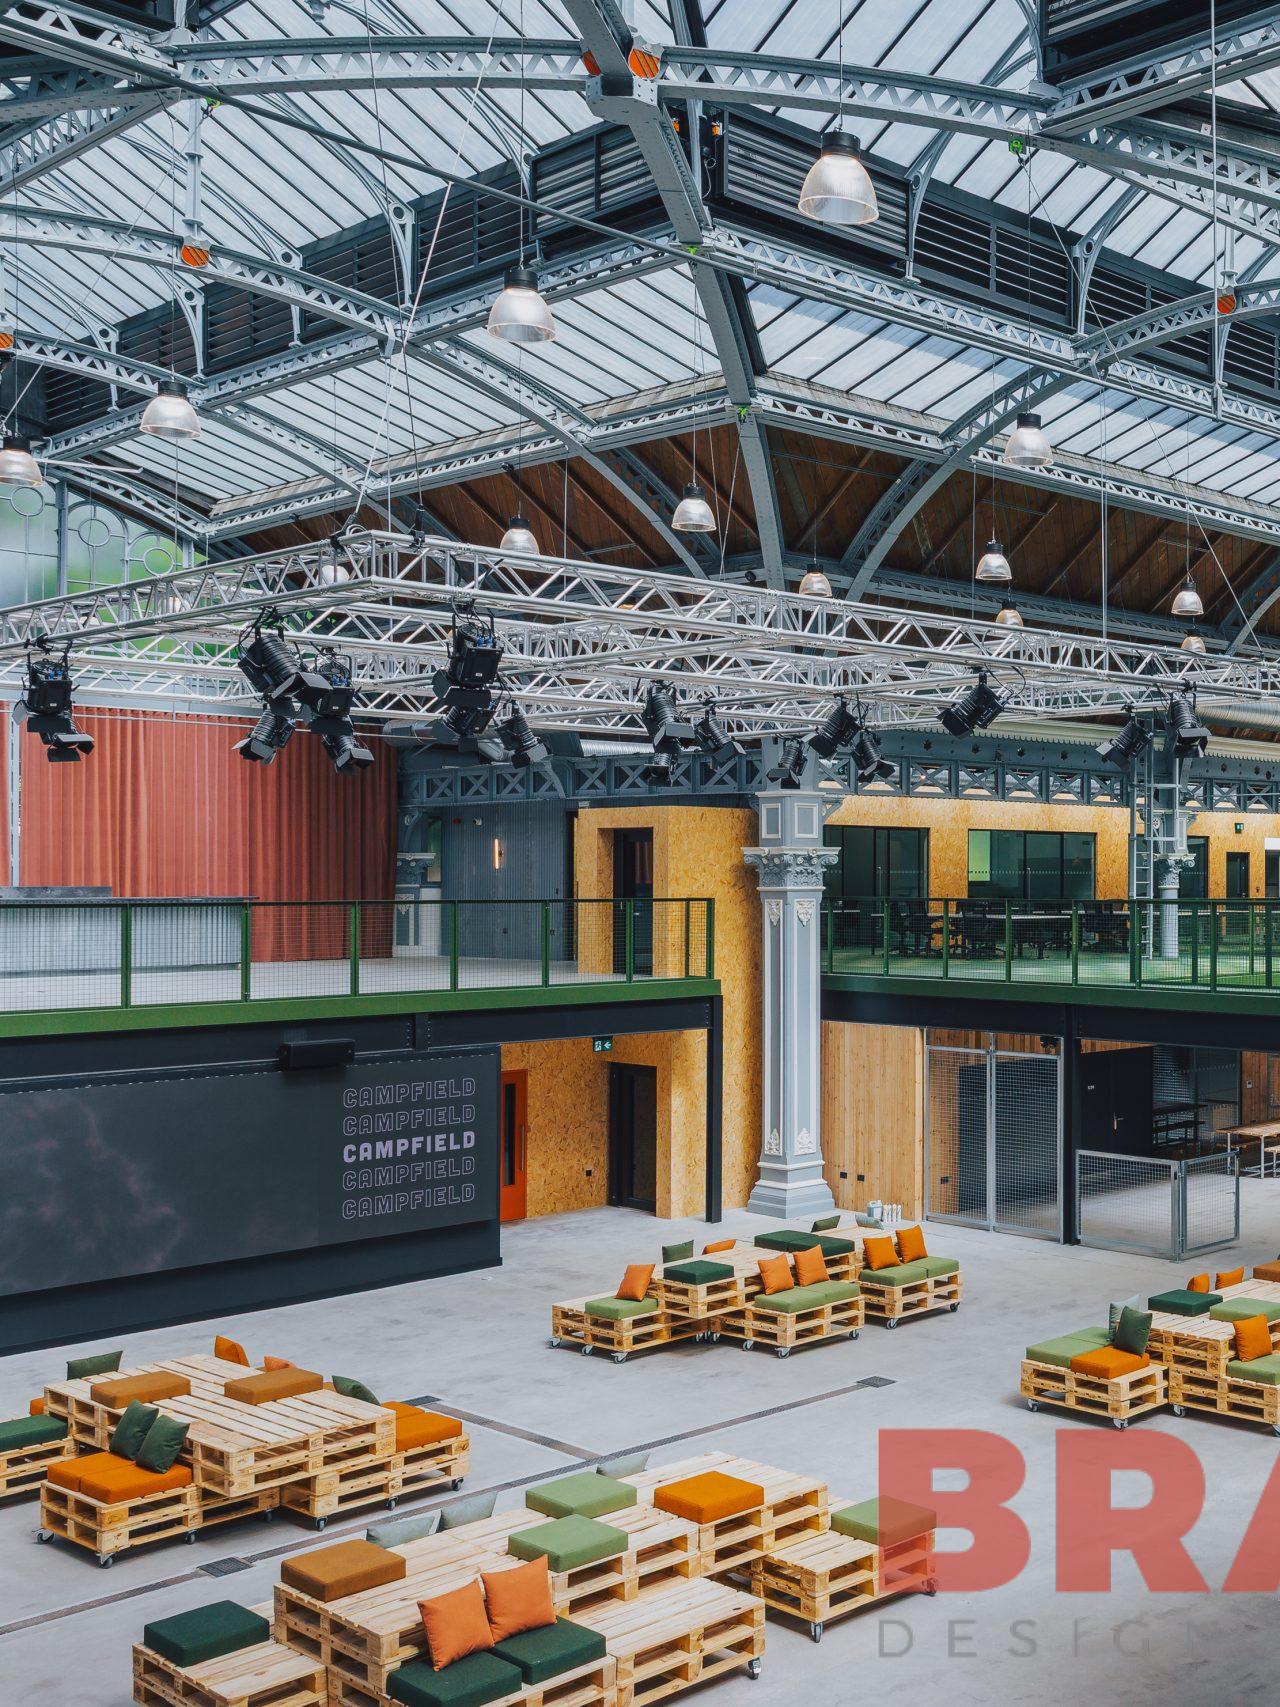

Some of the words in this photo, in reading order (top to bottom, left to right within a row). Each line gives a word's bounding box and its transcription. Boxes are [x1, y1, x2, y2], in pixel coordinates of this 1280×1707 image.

[343, 1078, 476, 1108] CAMPFIELD
[343, 1104, 476, 1136] CAMPFIELD
[343, 1131, 475, 1163] CAMPFIELD
[342, 1156, 475, 1191] CAMPFIELD
[342, 1183, 475, 1220] CAMPFIELD
